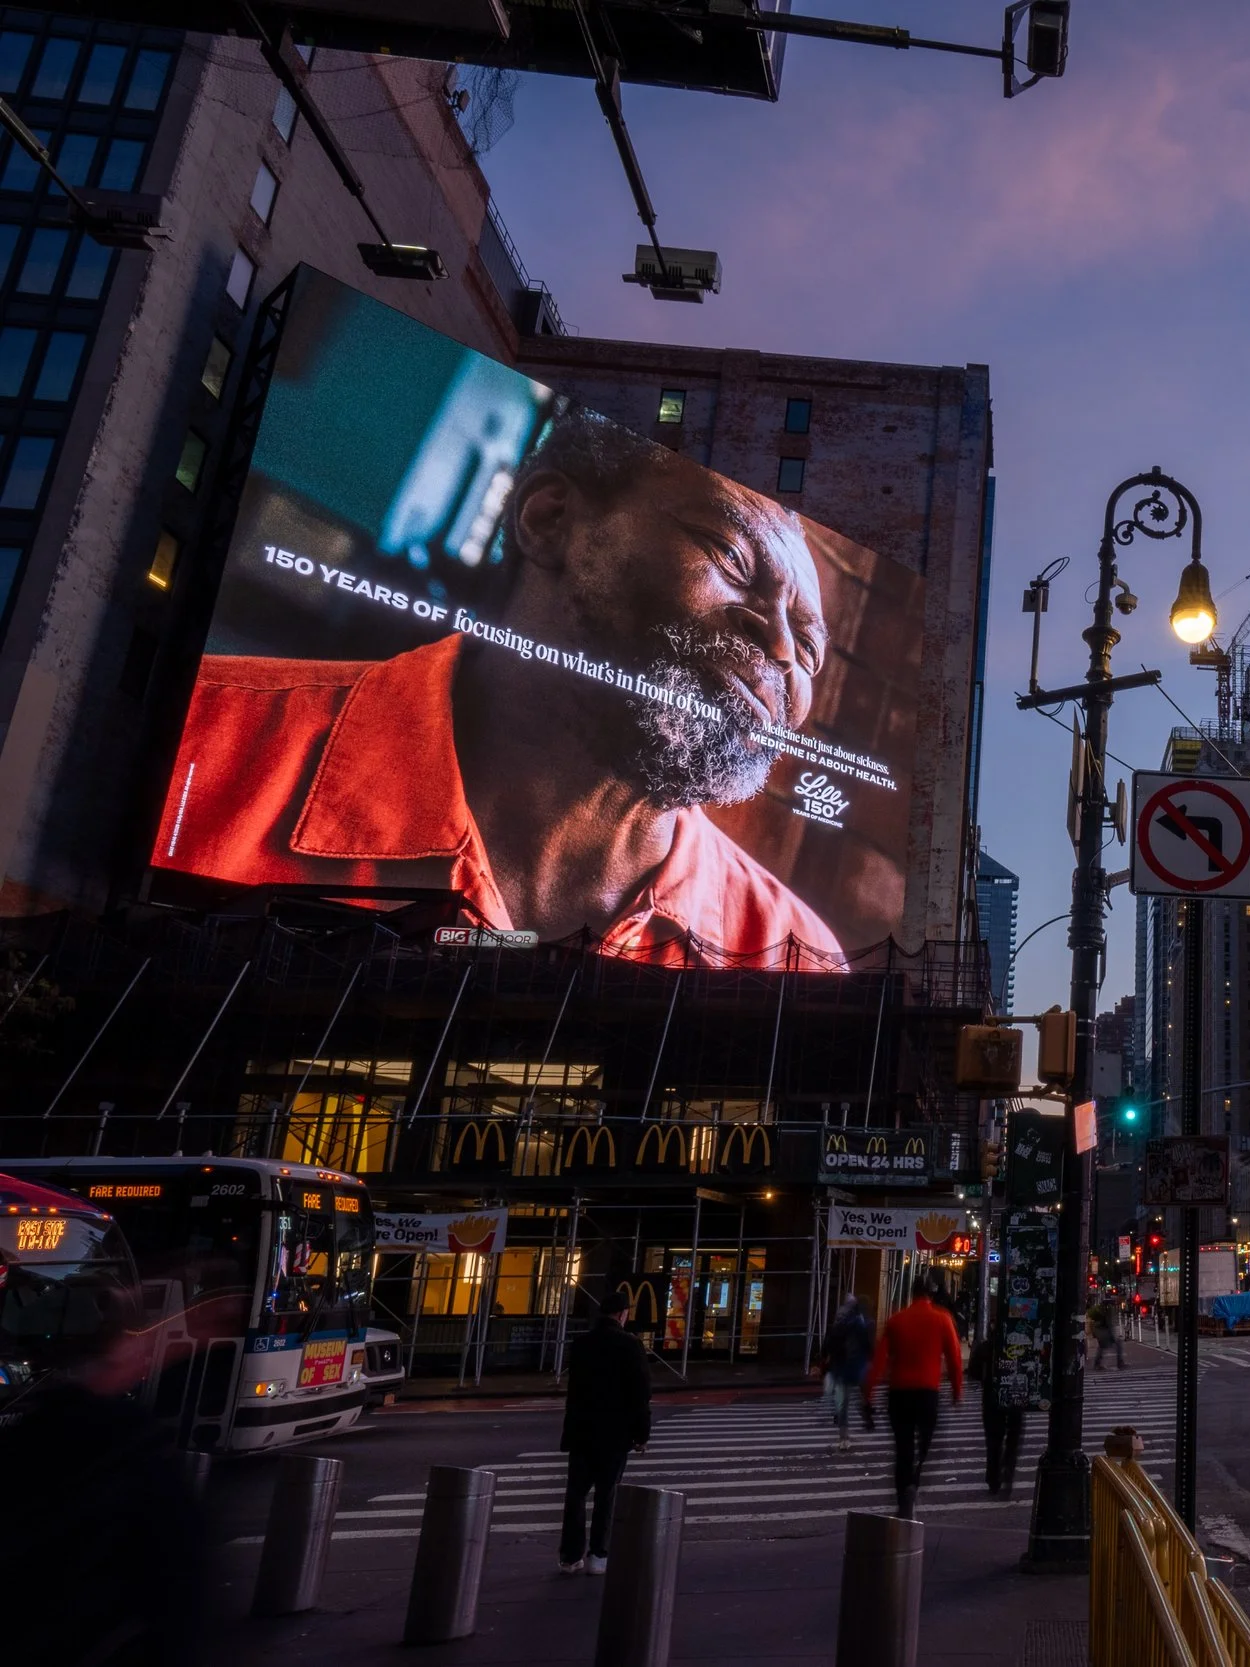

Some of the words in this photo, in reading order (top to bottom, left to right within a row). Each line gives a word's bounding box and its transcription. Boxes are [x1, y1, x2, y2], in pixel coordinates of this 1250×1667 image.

[264, 545, 314, 575] 150
[319, 563, 409, 610] YEARS
[413, 600, 448, 622] OF
[453, 608, 534, 660] focusing
[535, 643, 560, 664] on
[562, 651, 615, 683] what's
[615, 668, 634, 693] in
[634, 674, 675, 707] front
[676, 692, 698, 712] of
[694, 698, 722, 722] you
[762, 719, 801, 742] Medicine
[800, 734, 817, 750] isn't
[816, 740, 833, 754] just
[833, 746, 856, 763] about
[856, 754, 890, 775] sickness.
[750, 732, 805, 759] MEDICINE
[806, 752, 817, 763] IS
[818, 757, 855, 776] ABOUT
[855, 767, 897, 791] HEALTH.
[794, 772, 849, 816] Lilly
[803, 798, 835, 818] 150
[792, 807, 811, 820] YEARS
[817, 815, 843, 829] MEDICINE
[439, 930, 466, 942] BIG
[825, 1153, 869, 1168] OPEN
[871, 1155, 890, 1169] 24
[893, 1156, 925, 1170] HRS
[89, 1186, 114, 1198] FARE
[115, 1185, 161, 1198] REQUIRED
[211, 1184, 245, 1196] 2602
[303, 1192, 321, 1209] FARE
[334, 1196, 359, 1213] REQUIRED
[375, 1217, 395, 1229] es,
[398, 1218, 422, 1228] We
[840, 1210, 867, 1225] Yes,
[870, 1212, 892, 1224] We
[375, 1230, 391, 1240] re
[394, 1229, 438, 1242] Open!
[840, 1224, 864, 1236] Are
[866, 1225, 907, 1240] Open!
[304, 1340, 346, 1359] MUSEUM
[300, 1366, 316, 1384] OF
[322, 1363, 342, 1381] SEX
